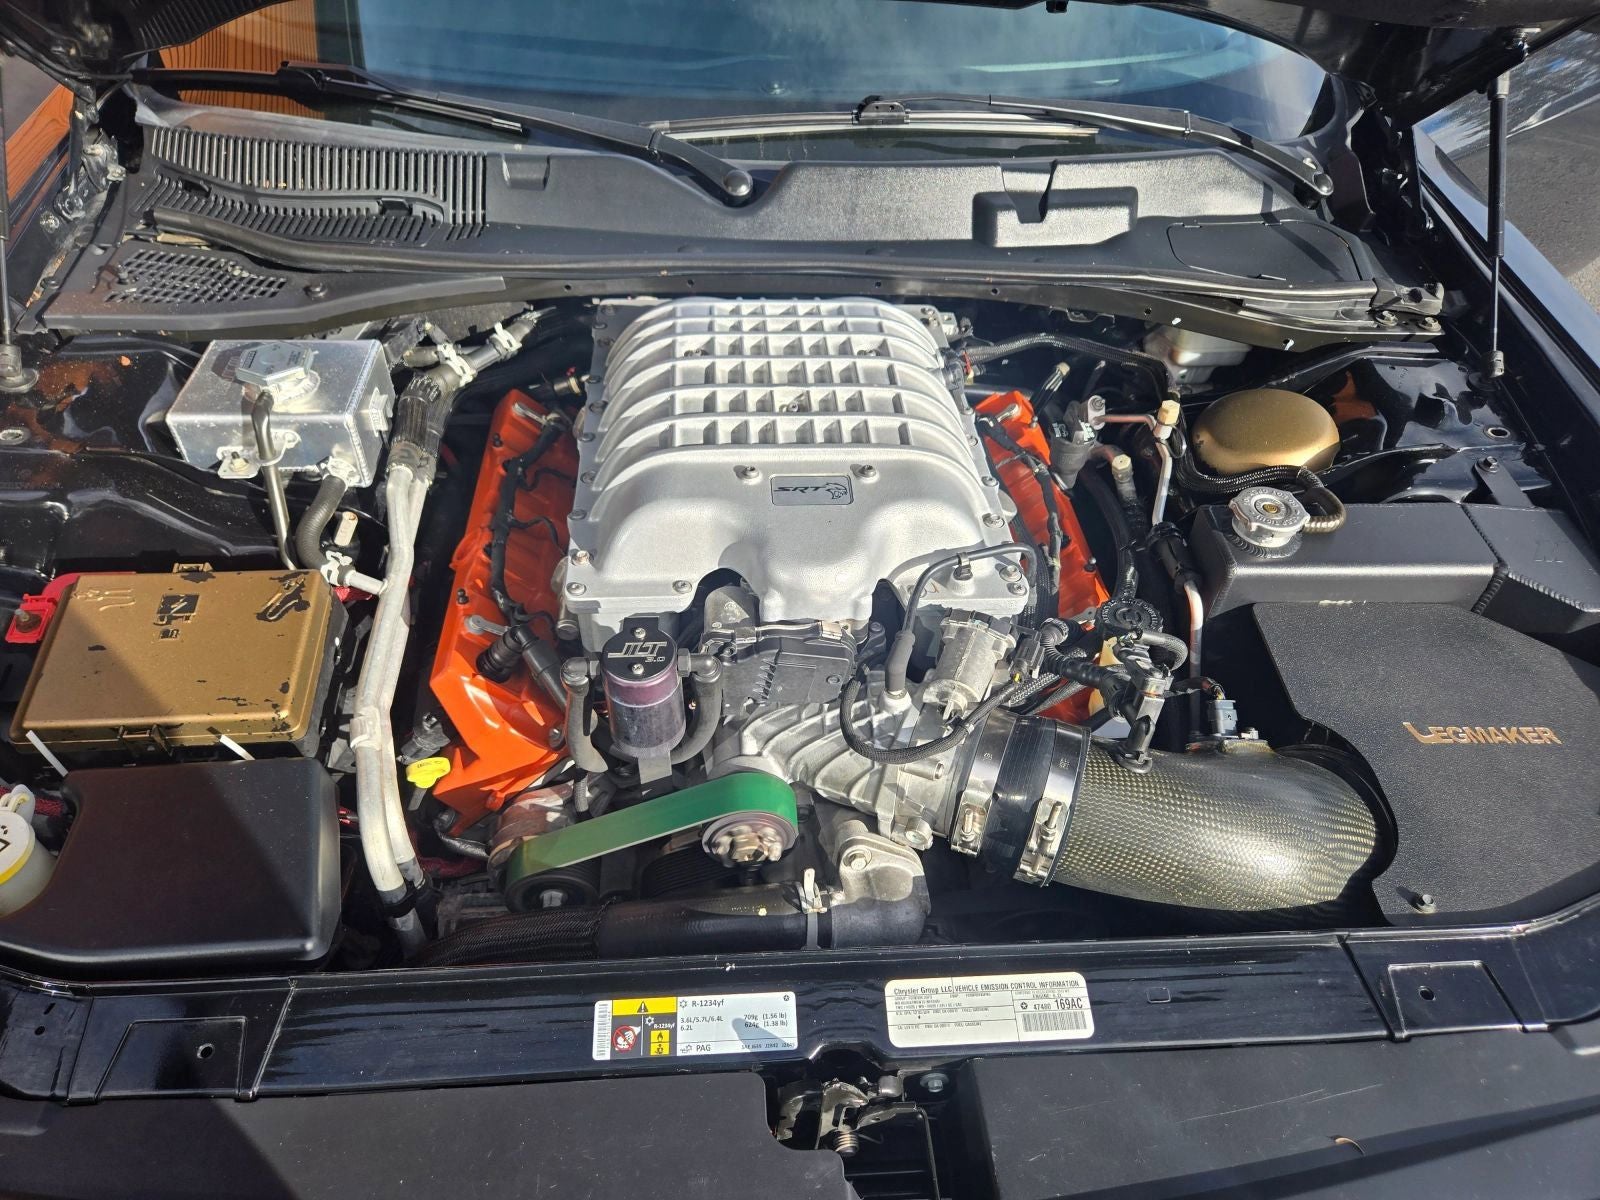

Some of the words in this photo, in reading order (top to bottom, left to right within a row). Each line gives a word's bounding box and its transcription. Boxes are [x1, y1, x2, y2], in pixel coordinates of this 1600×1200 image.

[608, 641, 667, 658] JLT
[1402, 721, 1562, 745] LEGMAKER
[920, 986, 939, 994] Group
[940, 985, 953, 993] LLC
[954, 984, 979, 992] VEHICLE
[980, 982, 1009, 990] EMISSION
[1010, 980, 1037, 990] CONTROL
[1038, 980, 1080, 988] INFORMATION
[691, 999, 725, 1007] R-1234yf
[1055, 998, 1083, 1009] 169AC
[743, 1013, 758, 1021] 709g
[762, 1012, 777, 1020] (1.56
[778, 1011, 787, 1019] lb)
[763, 1020, 778, 1028] (1.38
[779, 1019, 788, 1027] lb)
[696, 1044, 711, 1052] PAG
